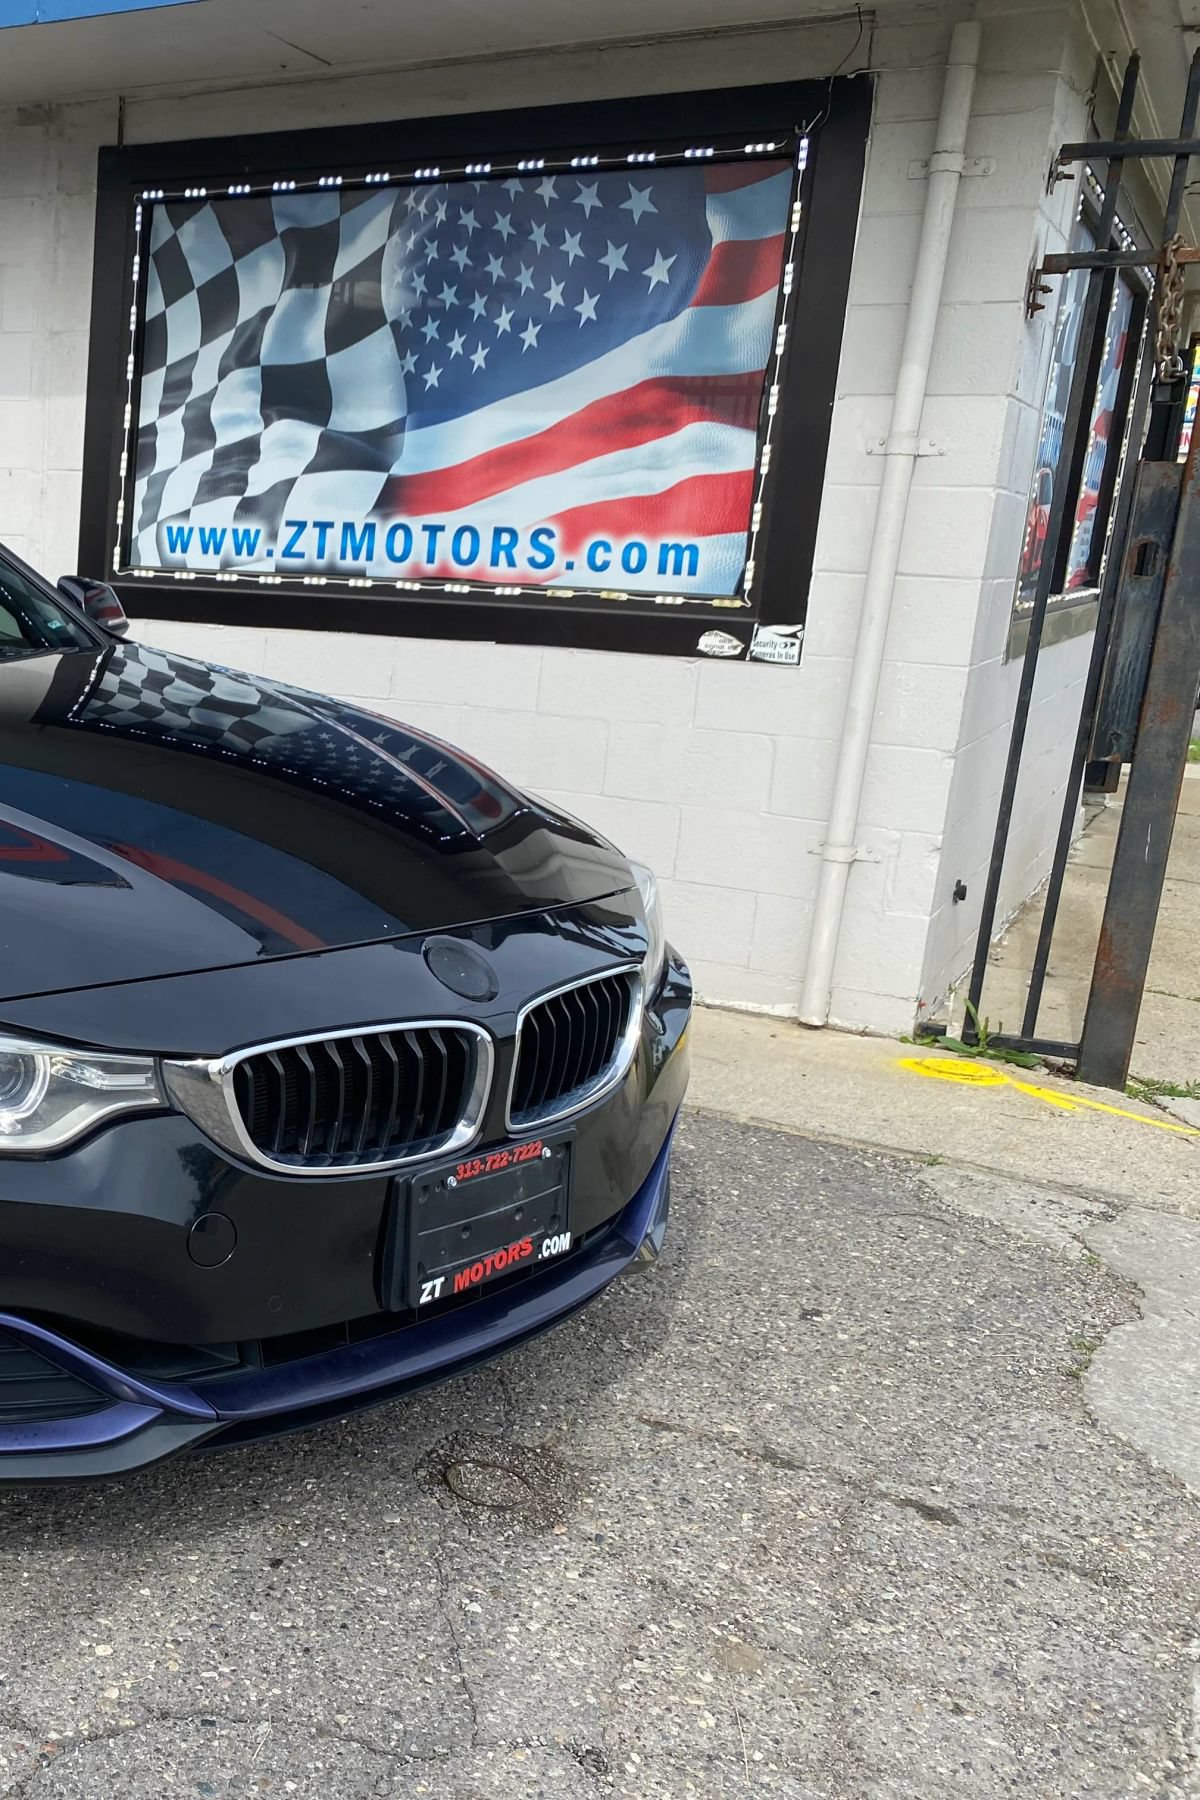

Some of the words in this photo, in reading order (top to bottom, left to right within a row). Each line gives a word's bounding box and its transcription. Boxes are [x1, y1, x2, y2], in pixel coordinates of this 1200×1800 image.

[165, 519, 700, 577] www.ZTMOTORS.com
[455, 1140, 544, 1181] 313-722-7222
[419, 1275, 446, 1305] ZT
[453, 1235, 534, 1294] MOTORS
[537, 1231, 572, 1260] .COM
